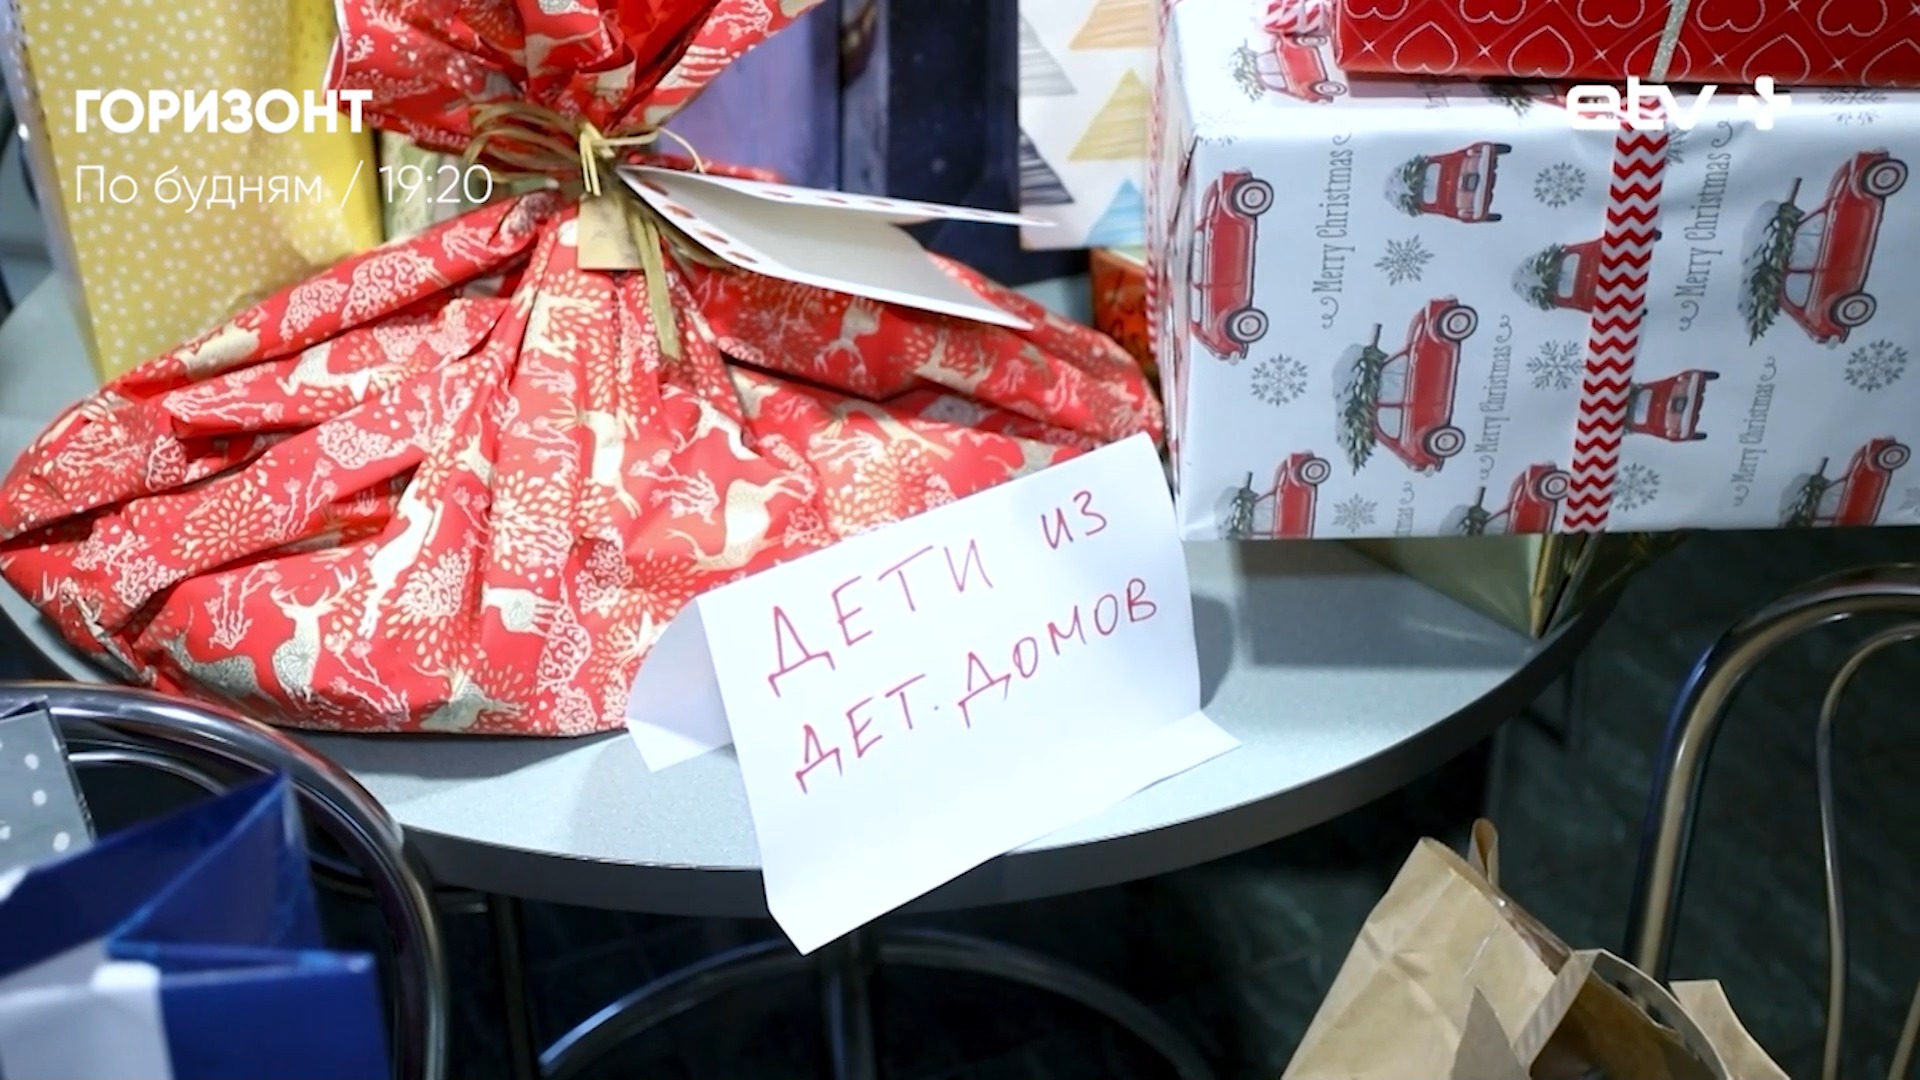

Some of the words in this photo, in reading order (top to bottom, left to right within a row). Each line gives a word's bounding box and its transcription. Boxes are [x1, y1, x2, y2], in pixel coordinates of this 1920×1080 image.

[1316, 149, 1354, 239] Christmas
[1685, 151, 1732, 243] Christmas
[1312, 243, 1355, 294] Merry
[1674, 246, 1723, 298] Merry
[1479, 344, 1512, 413] Christmas
[1474, 415, 1511, 453] Merry
[1739, 383, 1776, 445] Christmas
[1730, 447, 1768, 484] Merry
[768, 539, 994, 698] ДЕТИ
[1041, 490, 1108, 549] ИЗ
